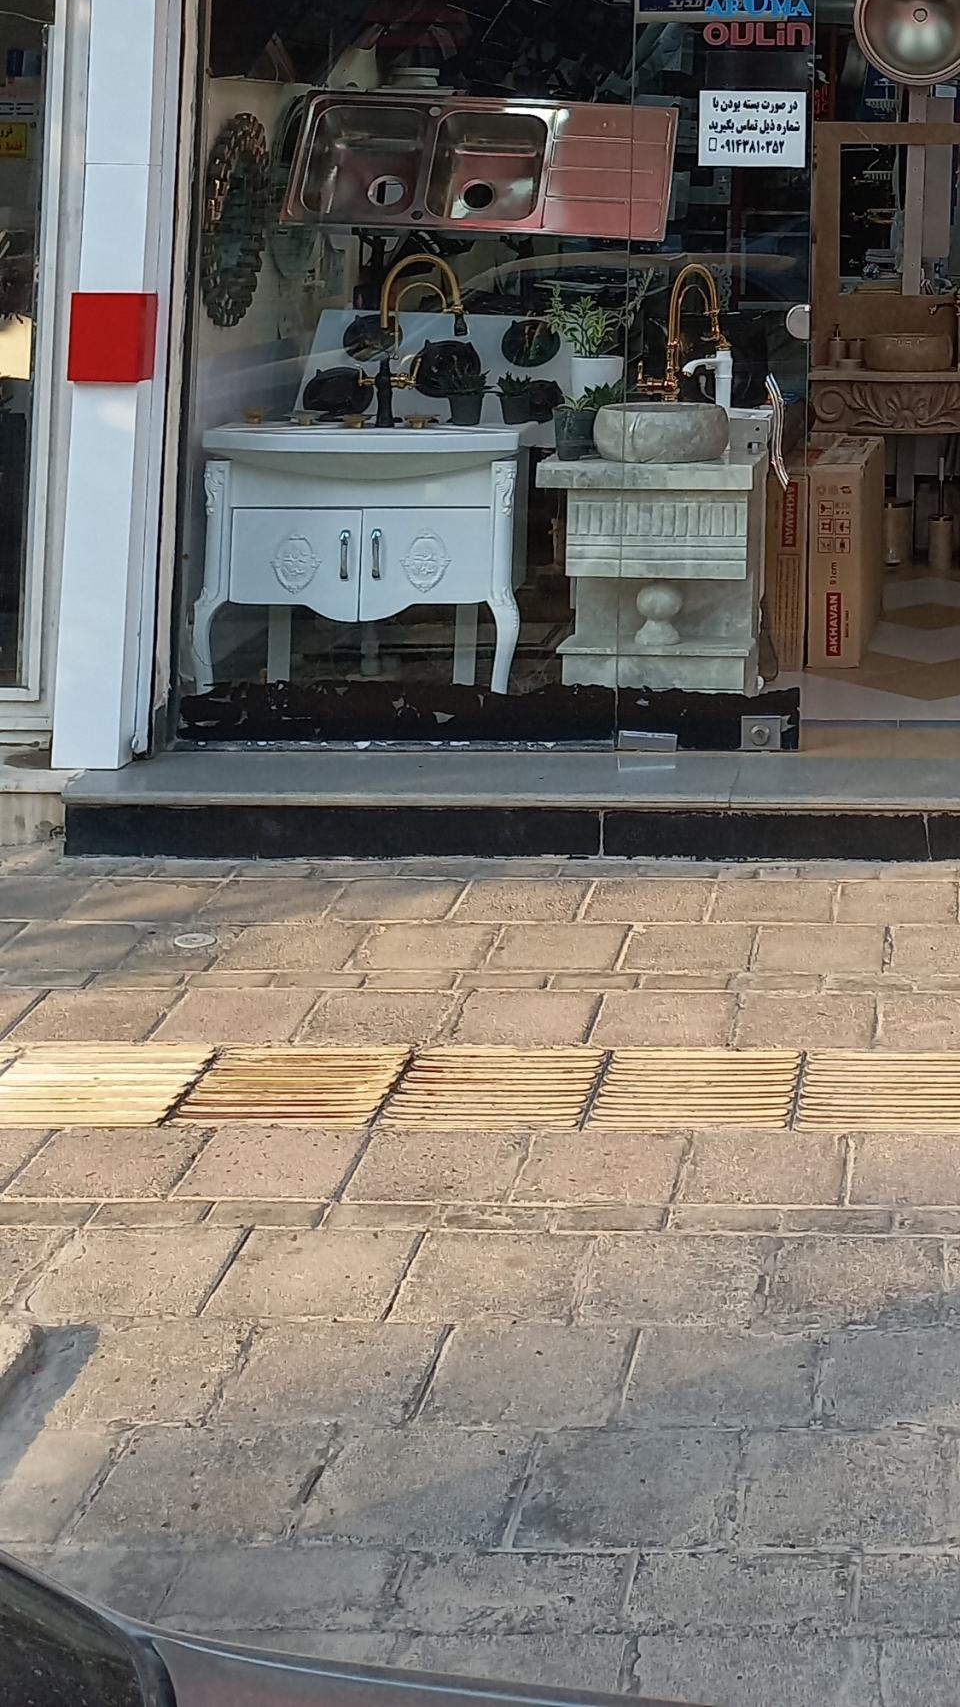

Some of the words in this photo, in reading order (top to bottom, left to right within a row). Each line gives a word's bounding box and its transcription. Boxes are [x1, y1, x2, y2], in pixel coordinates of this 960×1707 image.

[712, 96, 719, 112] با
[720, 99, 741, 113] بودن
[743, 99, 760, 113] بسته
[761, 99, 786, 114] صورت
[788, 100, 798, 114] در
[708, 118, 735, 134] بگیرید
[736, 118, 758, 135] تماس
[759, 118, 775, 135] ذیل
[776, 119, 801, 135] شماره
[720, 139, 785, 154] ۰۹۱۴۳۸۱۰۳۵۲
[783, 486, 797, 546] AKHAVAN
[828, 595, 839, 654] AKHAVAN
